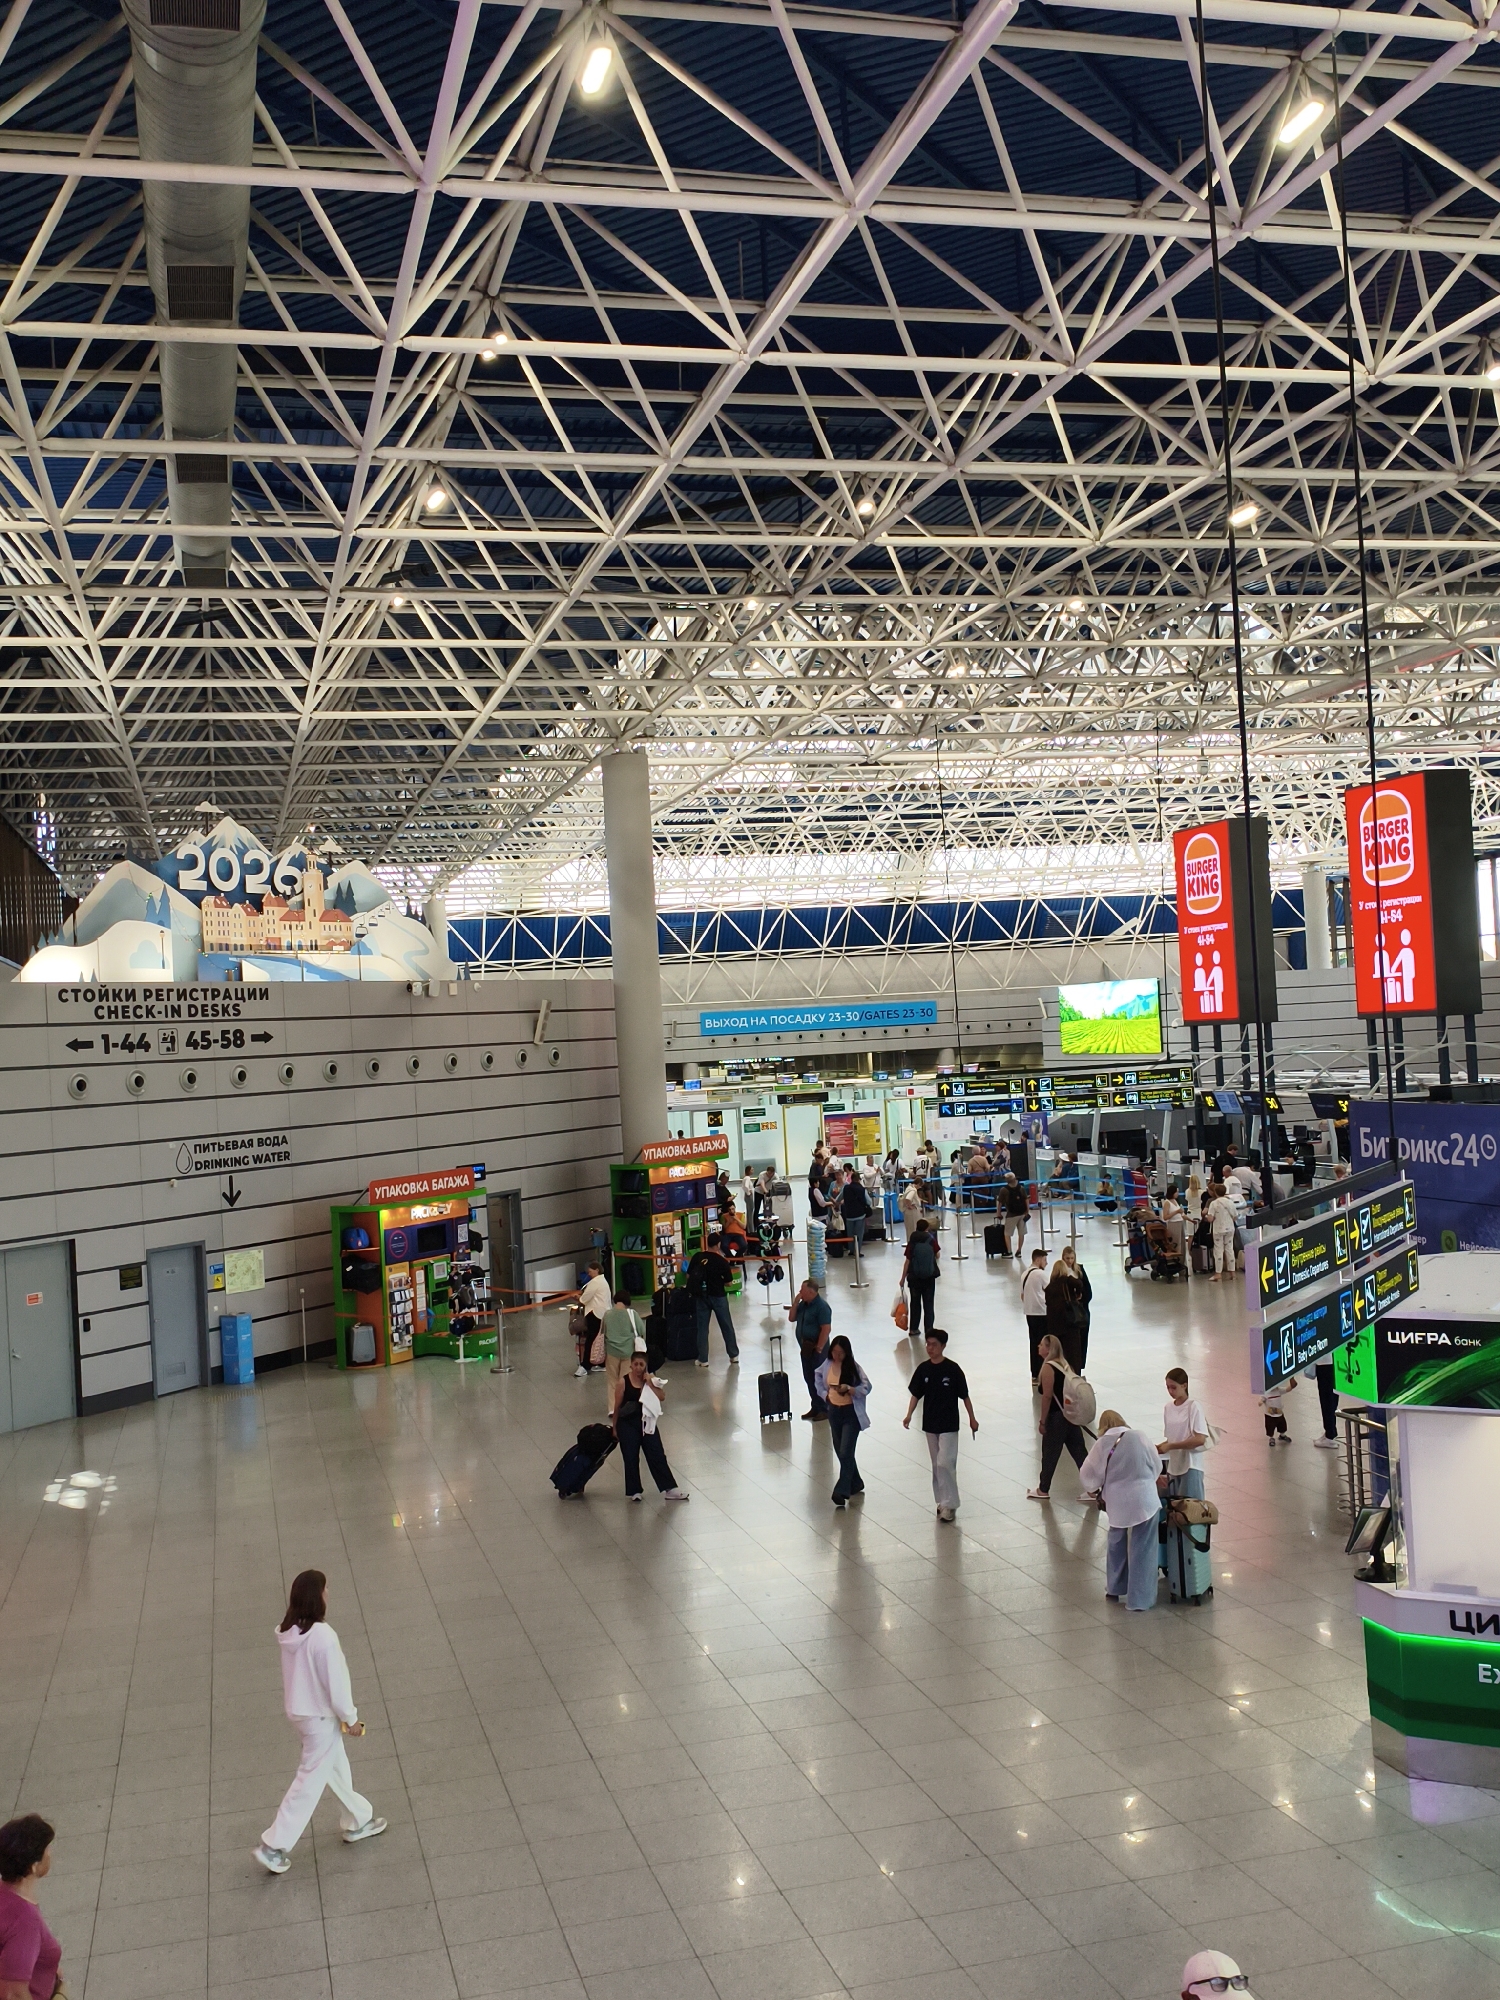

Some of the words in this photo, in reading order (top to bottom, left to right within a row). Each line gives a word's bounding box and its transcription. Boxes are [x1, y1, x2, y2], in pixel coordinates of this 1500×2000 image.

[1363, 818, 1409, 842] BURGER
[1364, 837, 1410, 868] KING
[177, 844, 304, 896] 2026
[1186, 857, 1218, 877] BURGER
[1187, 873, 1219, 898] KING
[58, 985, 137, 1003] СТОЙКИ
[143, 987, 270, 1003] РЕГИСТРАЦИИ
[94, 1004, 182, 1020] CHECK-IN
[187, 1003, 242, 1018] DESKS
[705, 1017, 748, 1028] ВЫХОД
[750, 1016, 768, 1026] НА
[770, 1013, 826, 1025] ПОСАДКУ
[902, 1008, 933, 1018] 23-30
[101, 1032, 152, 1055] 1-44
[185, 1029, 246, 1051] 45-58
[1265, 1097, 1279, 1109] 50
[193, 1138, 254, 1154] ПИТЬЕВАЯ
[257, 1135, 289, 1148] ВОДА
[643, 1144, 692, 1160] УПАКОВКА
[692, 1139, 727, 1154] БАГАЖА
[1360, 1127, 1480, 1167] Бирикс24
[194, 1155, 250, 1171] DRINKING
[251, 1151, 291, 1164] WATER
[374, 1180, 430, 1200] УПАКОВКА
[431, 1174, 470, 1191] БАГАЖА
[1292, 1267, 1310, 1285] Domestic
[1309, 1260, 1329, 1277] Departures
[1297, 1349, 1308, 1364] Baby
[1307, 1344, 1317, 1357] Care
[1316, 1338, 1329, 1351] Room
[1454, 1336, 1482, 1347] банк
